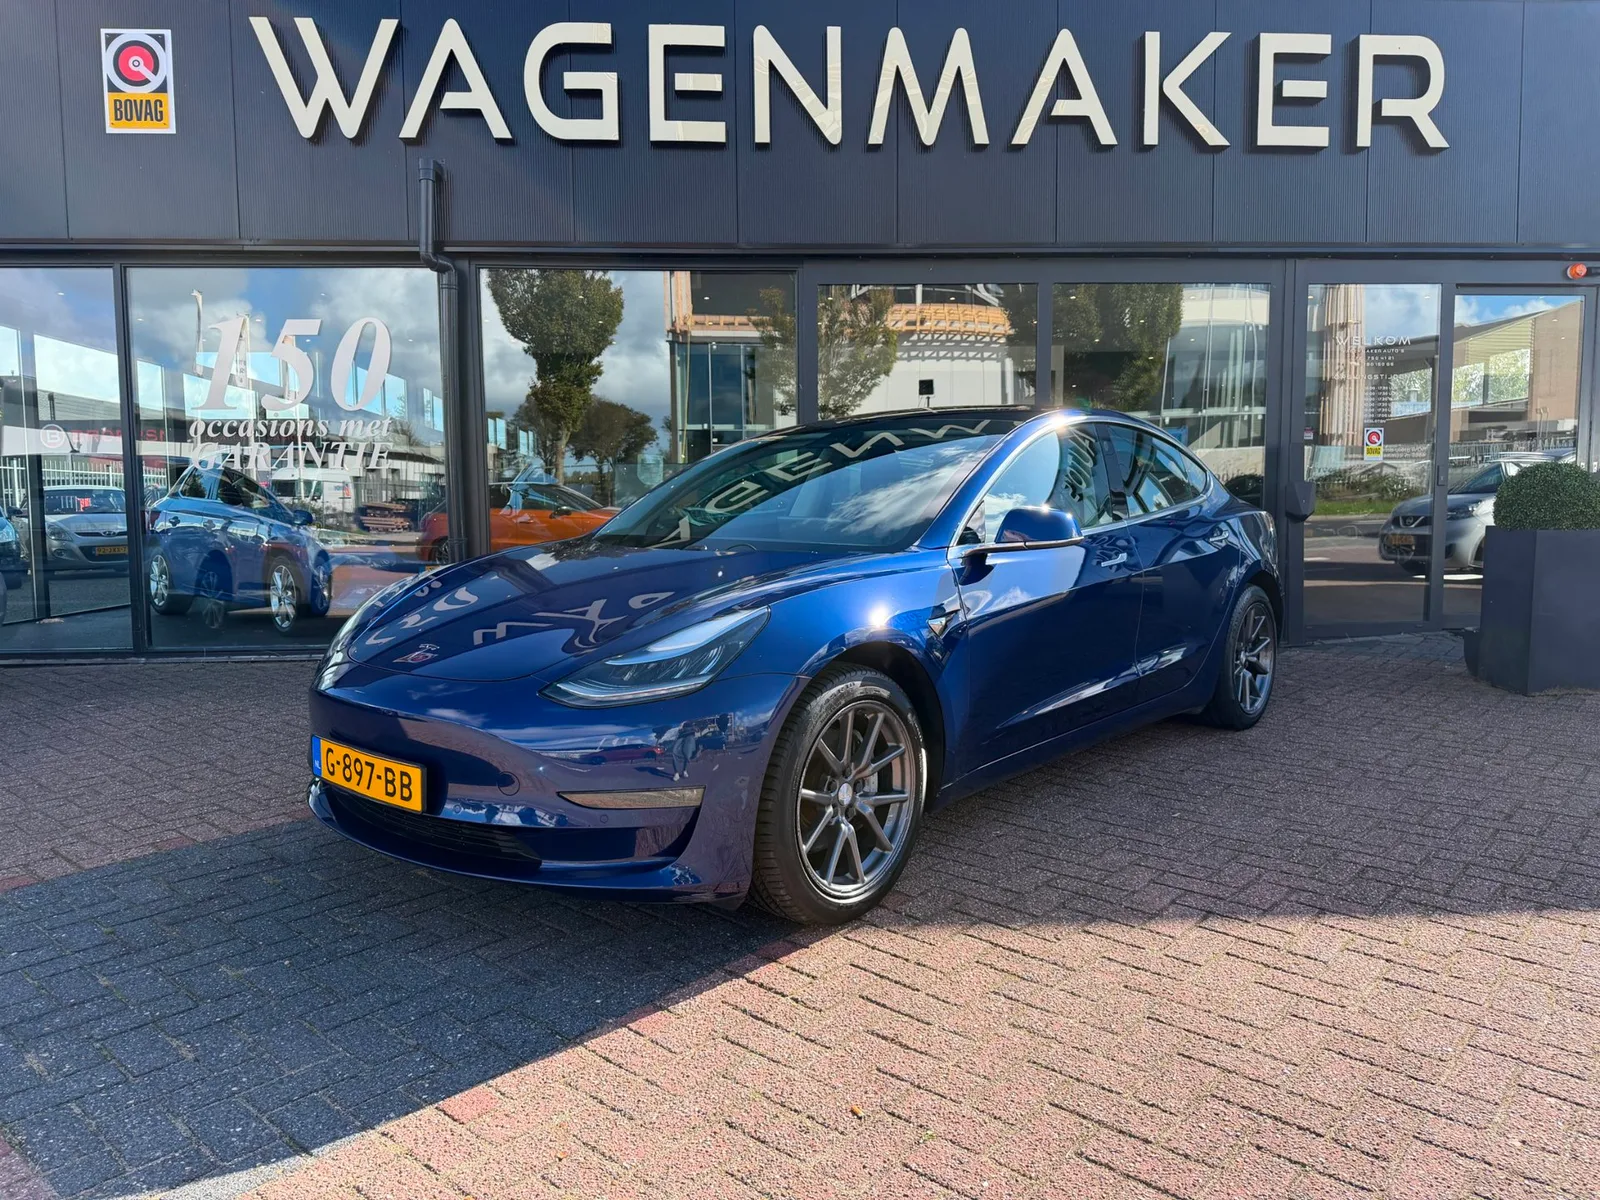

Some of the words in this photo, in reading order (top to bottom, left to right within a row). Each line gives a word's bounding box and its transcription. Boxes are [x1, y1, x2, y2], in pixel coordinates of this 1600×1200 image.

[249, 16, 1450, 148] WAGENMAKER
[113, 98, 164, 122] BOVAG
[1335, 335, 1411, 346] WELKOM
[190, 317, 392, 412] 150
[188, 418, 329, 438] occasions
[338, 417, 393, 438] met
[191, 441, 394, 471] GARANTIE
[326, 747, 413, 802] G-897-BB
